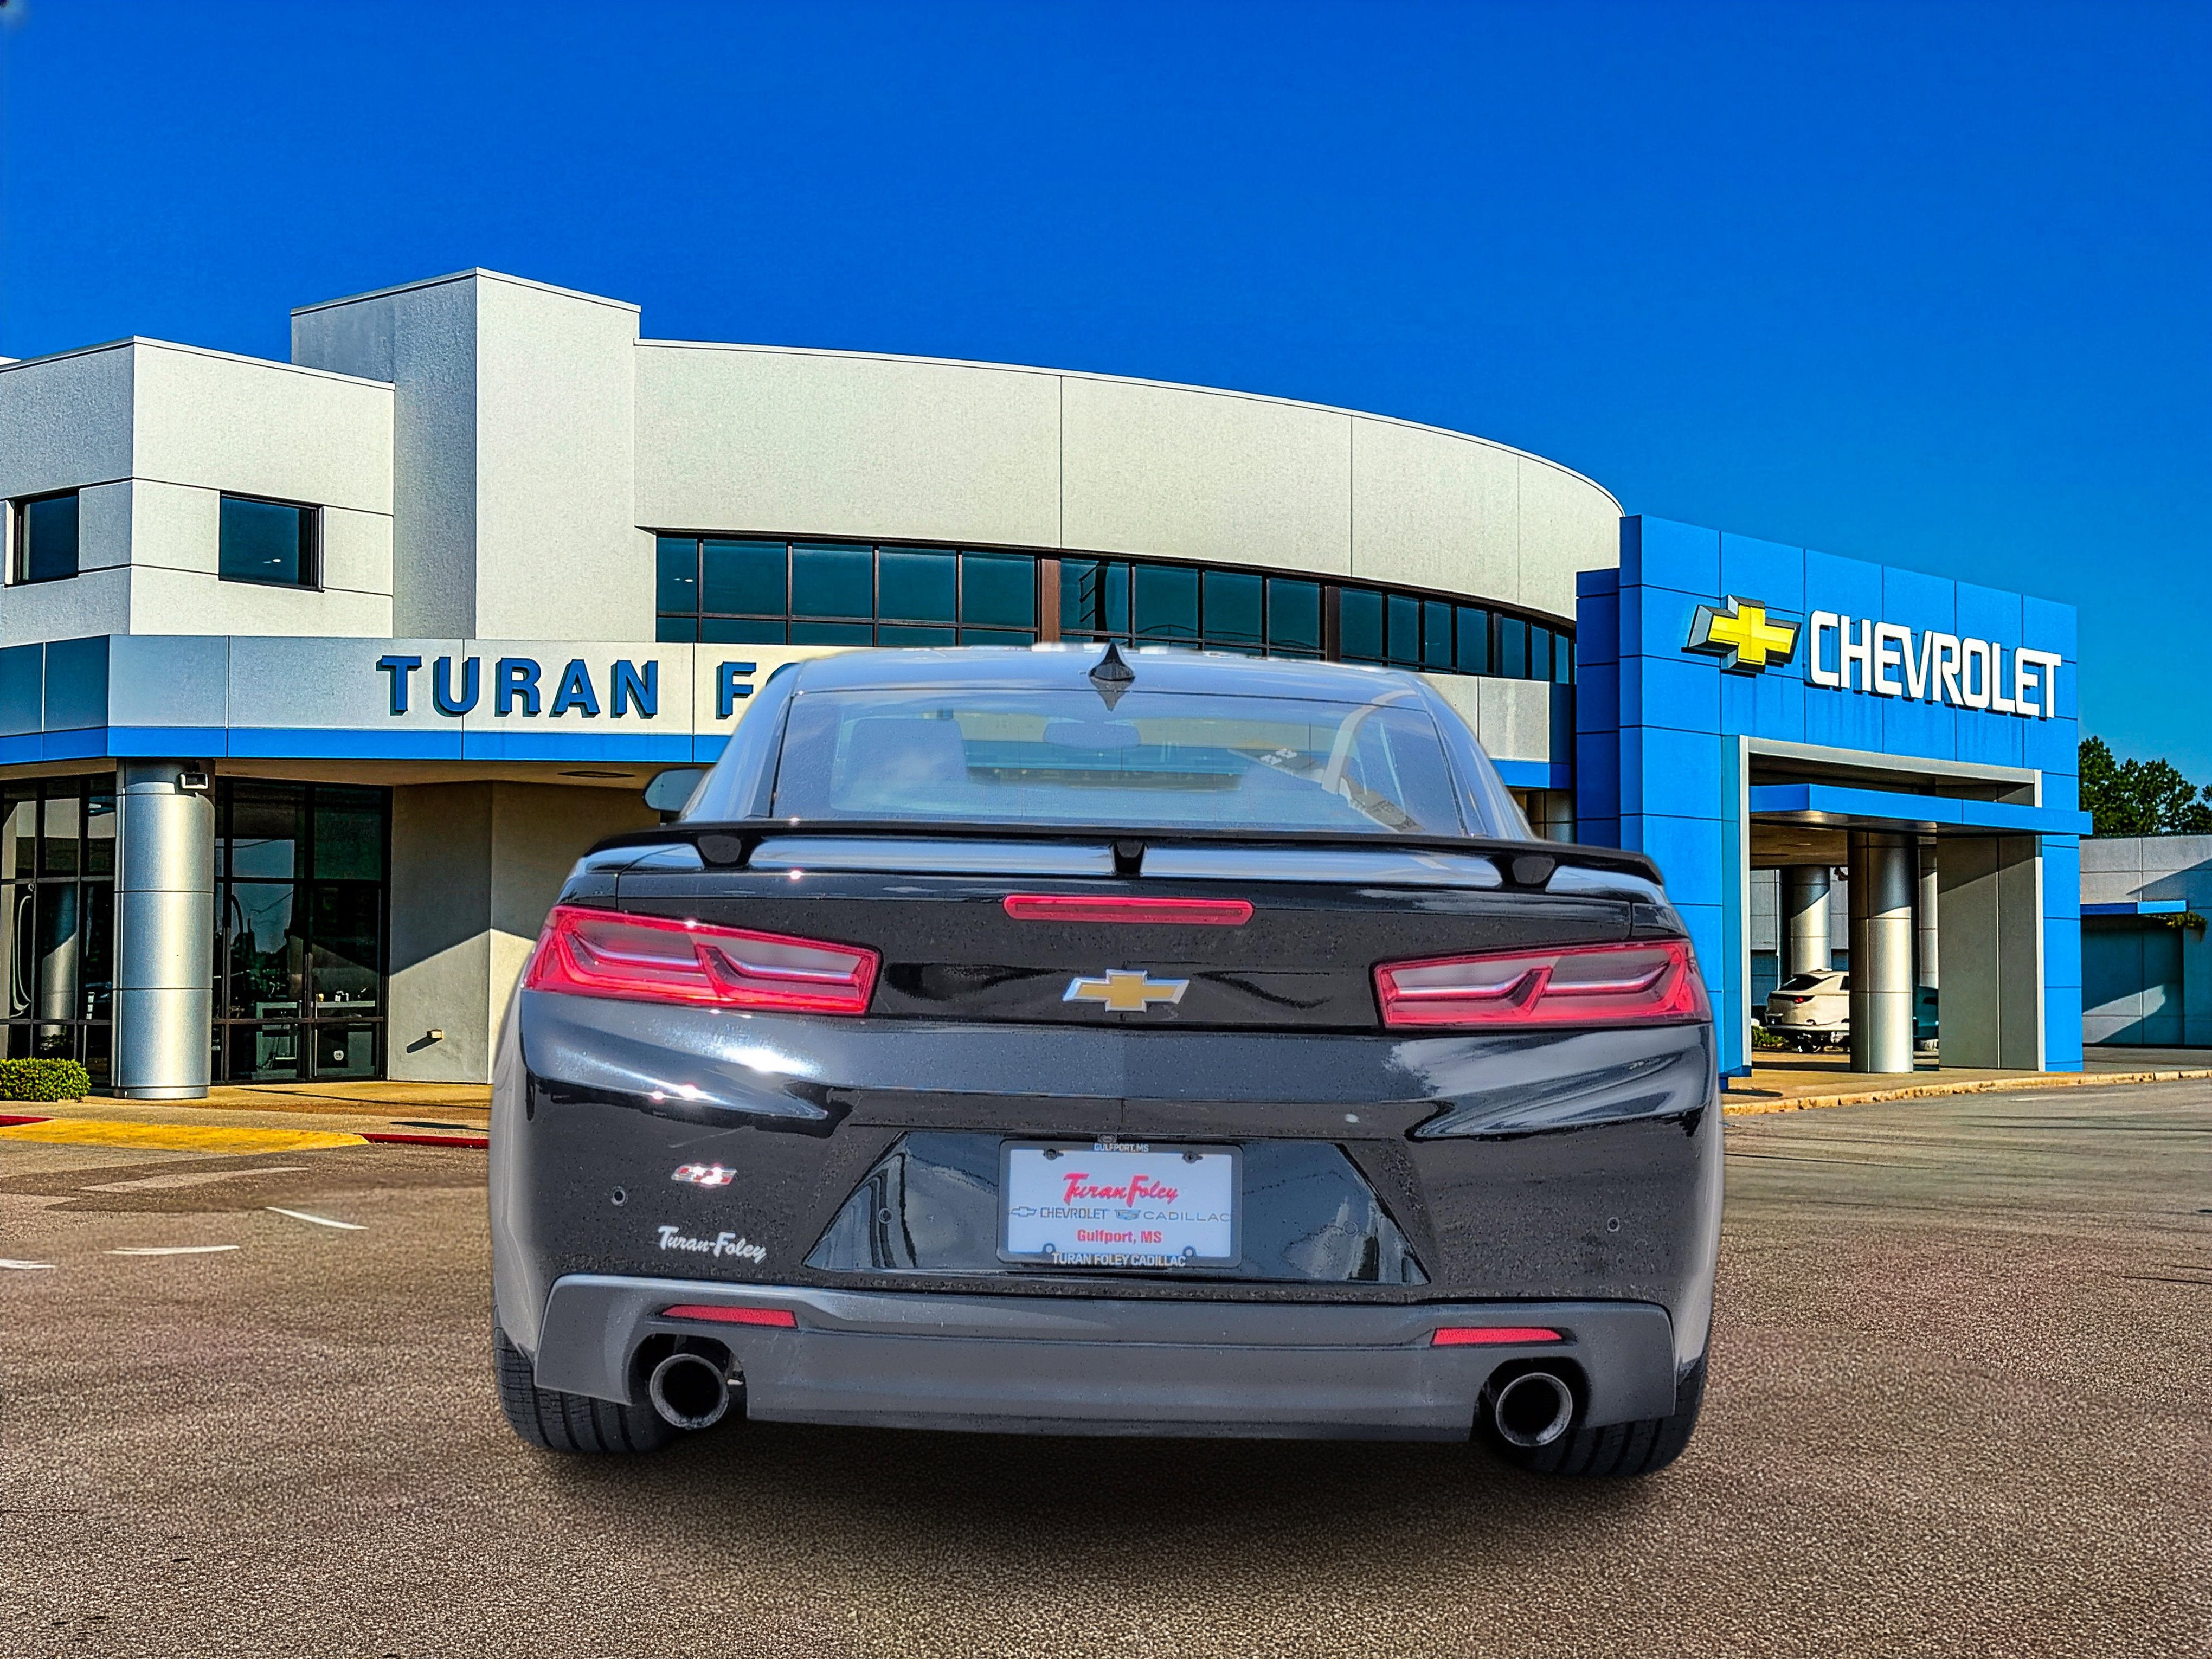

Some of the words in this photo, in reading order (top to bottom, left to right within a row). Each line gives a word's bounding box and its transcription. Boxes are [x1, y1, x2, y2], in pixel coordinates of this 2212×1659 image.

[1808, 609, 2062, 719] CHEVROLET
[376, 655, 658, 719] TURAN
[1040, 1207, 1110, 1220] CHEVROLET
[1143, 1211, 1231, 1221] CADILLAC
[1077, 1229, 1136, 1244] Gulfport,
[1140, 1231, 1162, 1244] MS
[1052, 1252, 1092, 1265] TURAN
[1094, 1253, 1128, 1266] FOLEY
[1130, 1255, 1186, 1268] CADILLAC
